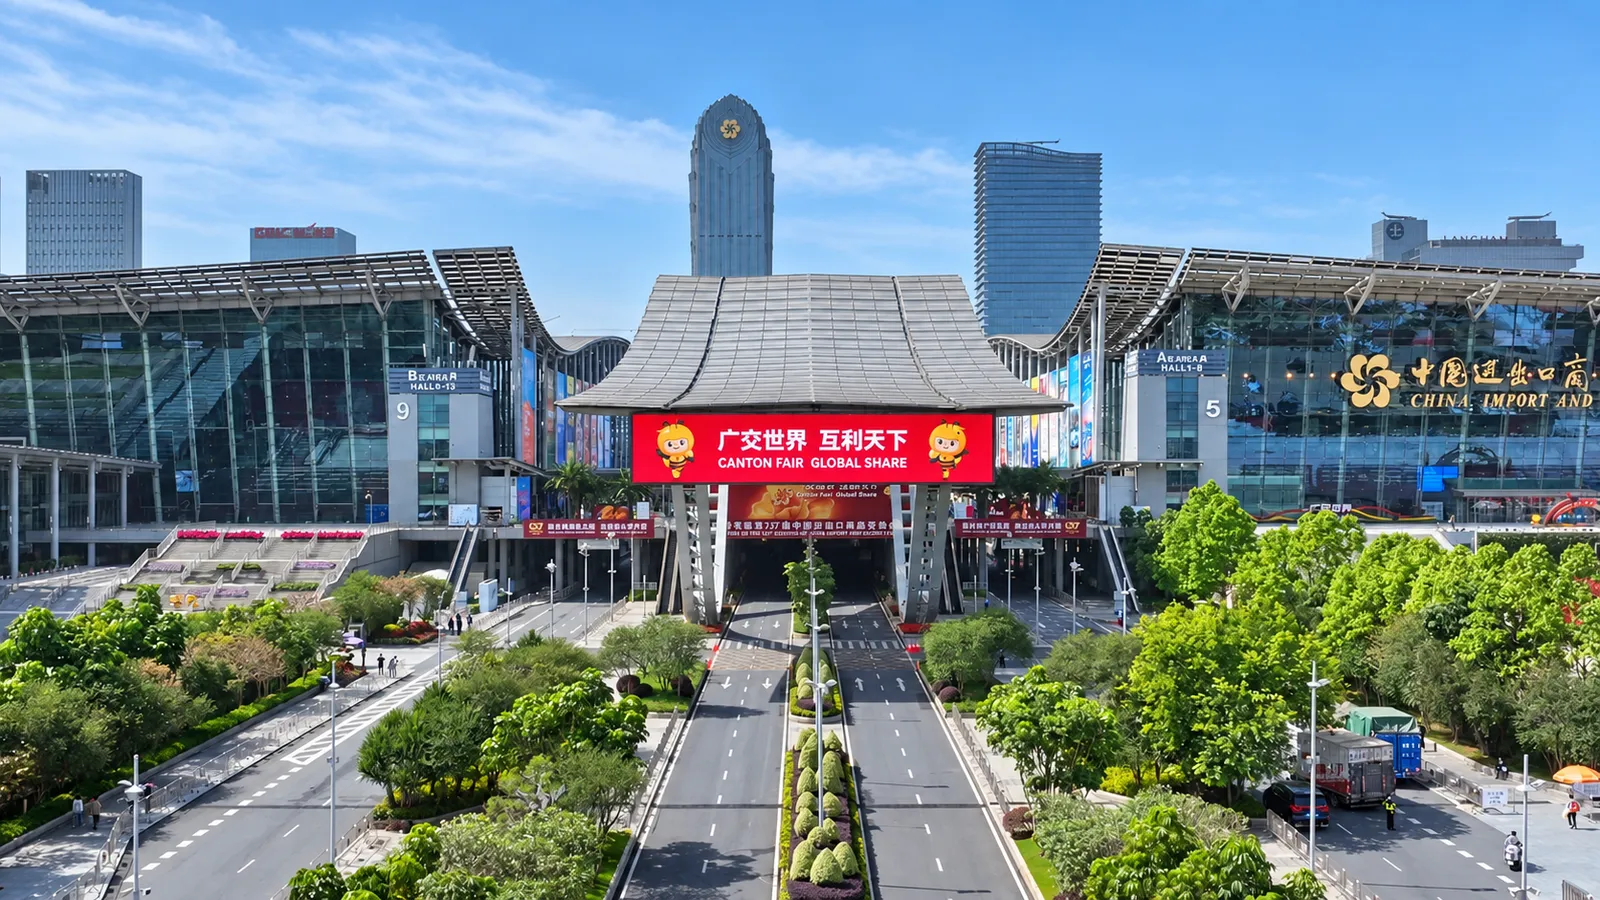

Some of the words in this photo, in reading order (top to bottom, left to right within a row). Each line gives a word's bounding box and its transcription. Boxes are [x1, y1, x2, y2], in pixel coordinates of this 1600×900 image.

[1205, 399, 1221, 418] 5
[1410, 393, 1468, 408] CHINA
[1483, 393, 1548, 408] IMPORT
[1556, 393, 1593, 408] AND
[396, 402, 410, 420] 9
[717, 428, 808, 452] 广交世界
[818, 428, 908, 452] 互利天下
[717, 457, 772, 469] CANTON
[775, 457, 804, 469] FAIR
[810, 457, 862, 469] GLOBAL
[863, 457, 908, 469] SHARE
